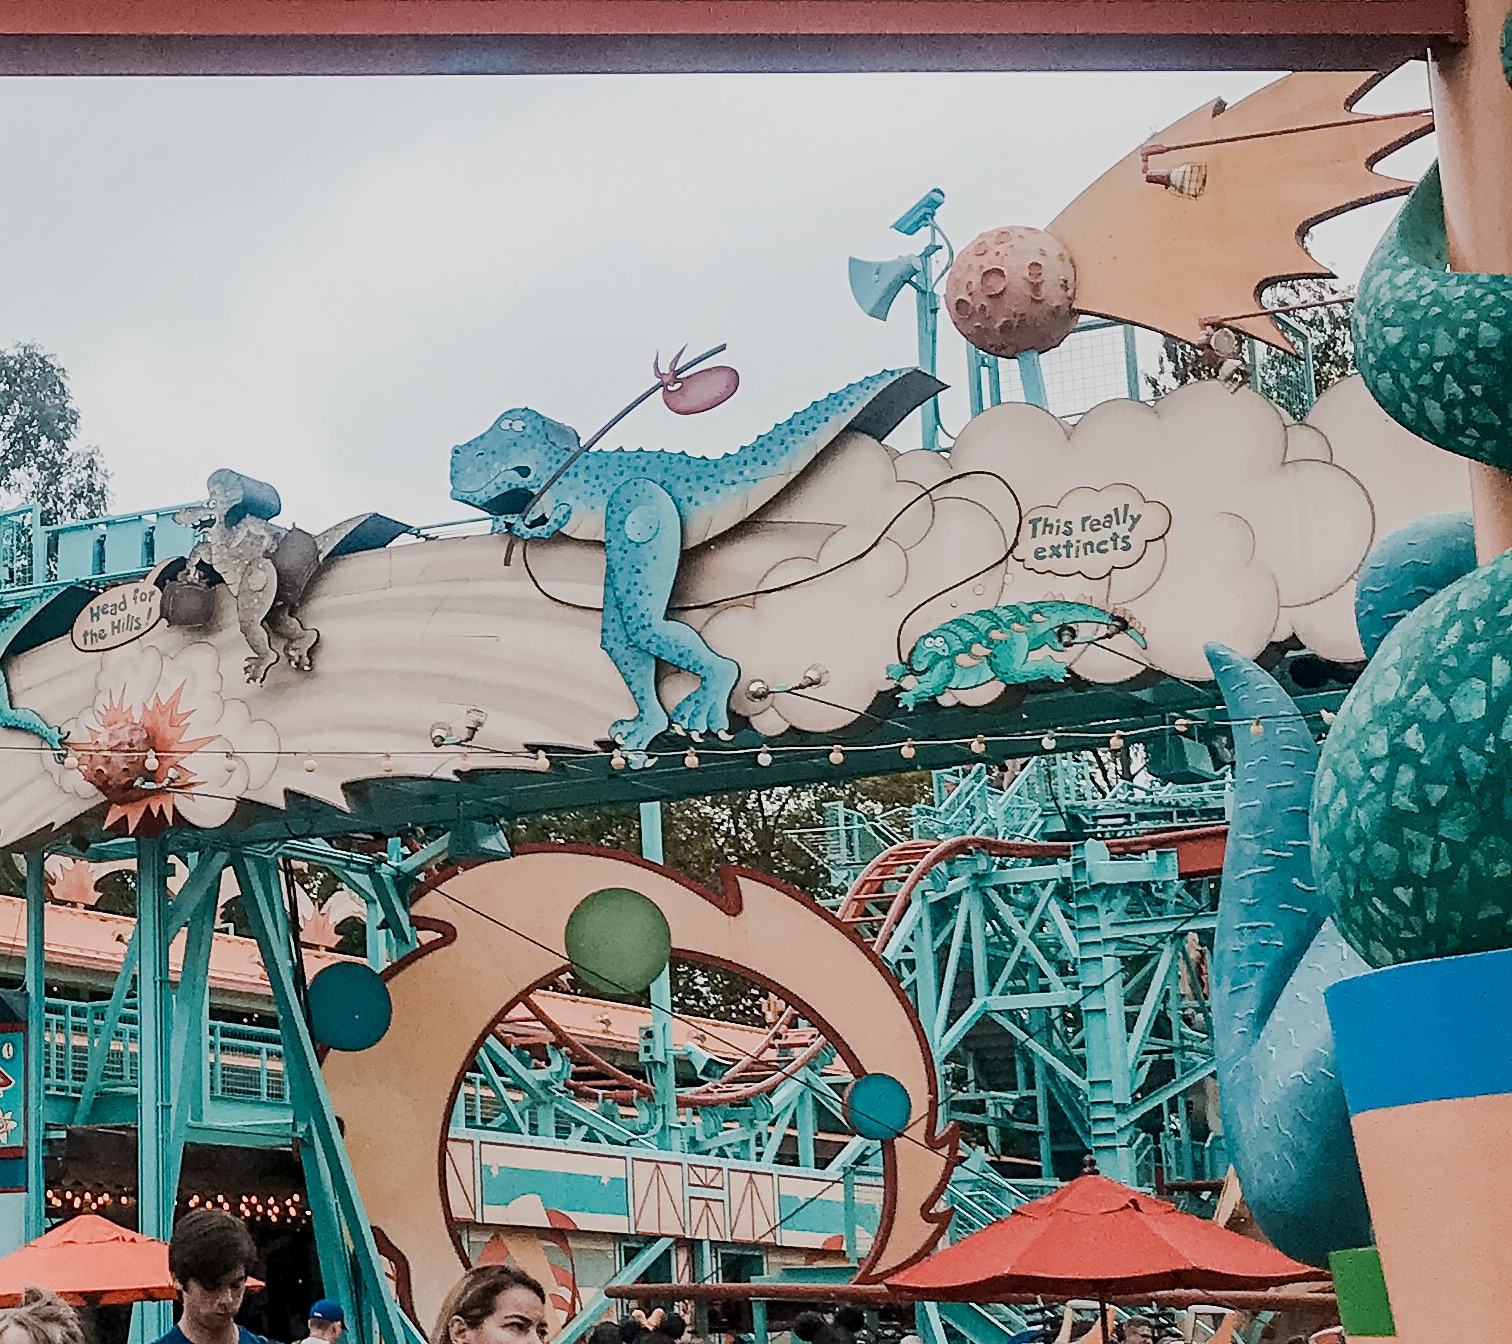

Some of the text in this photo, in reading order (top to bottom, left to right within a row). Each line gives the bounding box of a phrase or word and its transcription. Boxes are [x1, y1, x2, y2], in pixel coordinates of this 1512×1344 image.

[1028, 503, 1142, 540] This really
[1033, 532, 1132, 561] extincts
[89, 587, 157, 624] Head for
[82, 628, 108, 646] the
